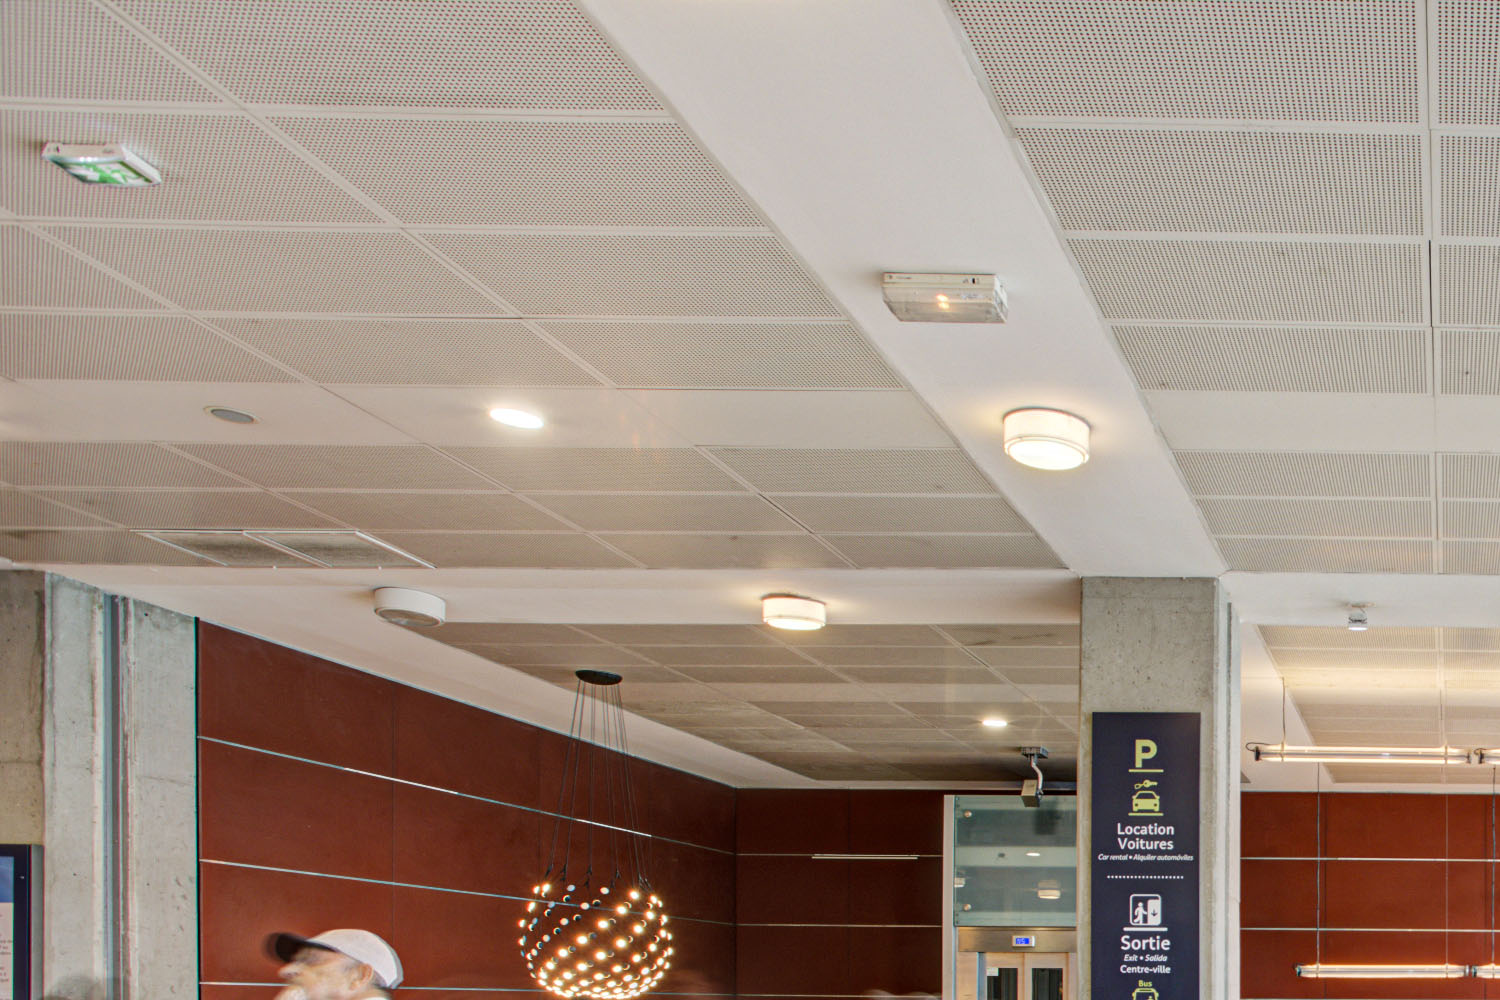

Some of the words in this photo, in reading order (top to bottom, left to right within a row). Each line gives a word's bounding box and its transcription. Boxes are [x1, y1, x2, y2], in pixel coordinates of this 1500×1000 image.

[1135, 739, 1157, 768] P
[1117, 823, 1174, 835] Location
[1117, 838, 1174, 849] Voitures
[1133, 854, 1156, 862] Alquiler
[1120, 935, 1171, 950] Sortie
[1120, 965, 1171, 973] Centre-ville
